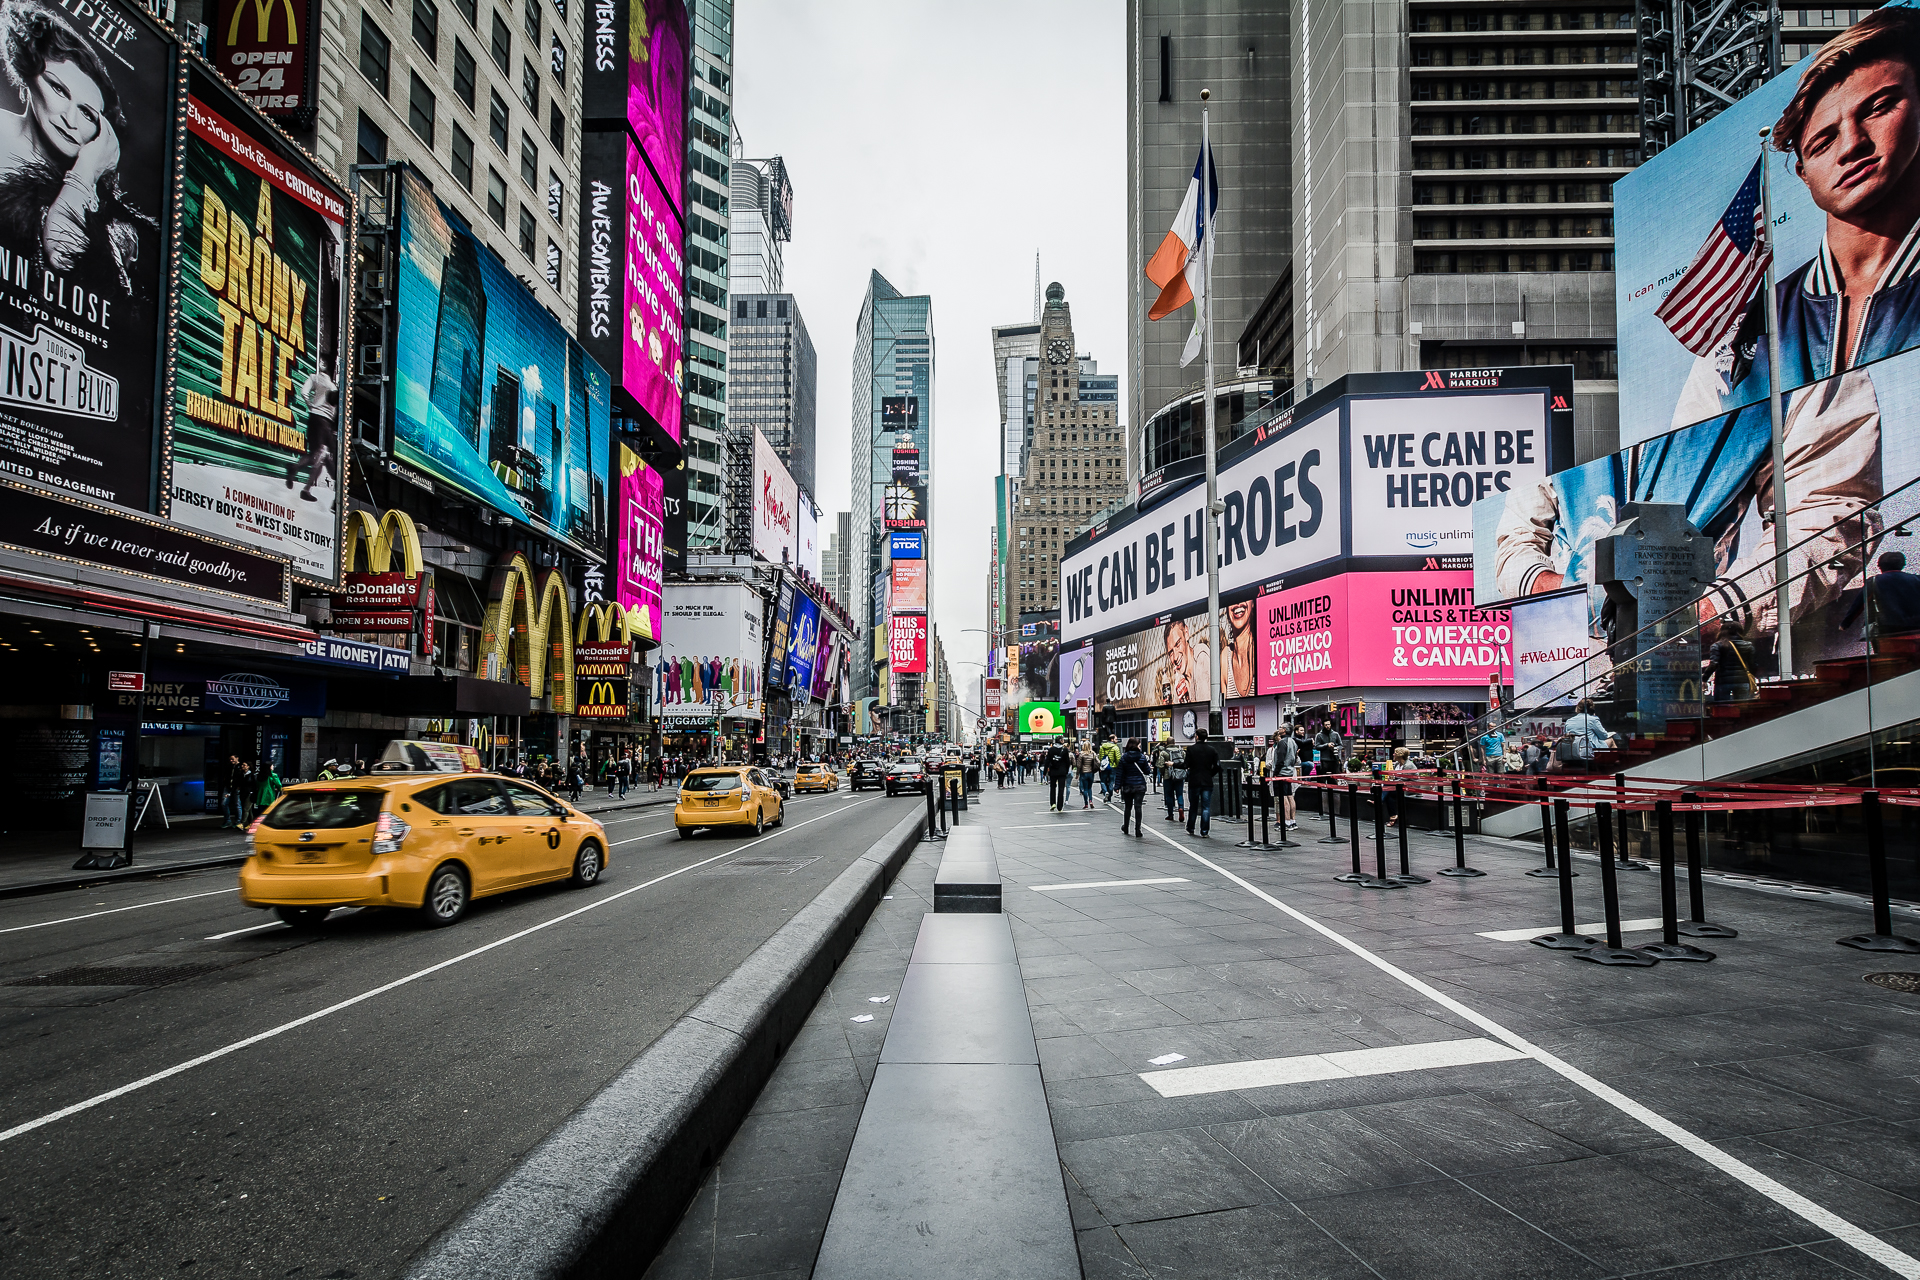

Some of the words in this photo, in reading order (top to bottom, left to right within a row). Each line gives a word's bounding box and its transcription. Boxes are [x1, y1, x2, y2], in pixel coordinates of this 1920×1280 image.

[231, 52, 293, 65] OPEN
[238, 68, 285, 90] 24
[187, 101, 206, 126] The
[207, 117, 230, 143] New
[230, 132, 256, 163] York
[255, 150, 285, 181] Times
[324, 196, 345, 218] PICK
[255, 178, 273, 243] A
[629, 173, 655, 227] Our
[655, 218, 684, 278] show
[201, 184, 306, 353] BRONX
[590, 179, 612, 339] AWESOMENESS
[629, 211, 684, 316] Foursome
[1634, 283, 1654, 299] can
[1657, 265, 1688, 286] make
[29, 294, 38, 304] in
[43, 270, 111, 330] CLOSE
[628, 252, 659, 316] have
[660, 303, 680, 346] you
[9, 296, 49, 321] LLOYD
[54, 316, 109, 349] WEBBER'S
[46, 339, 68, 360] 10086
[218, 298, 294, 422] TALE
[1450, 369, 1504, 378] MARRIOTT
[1450, 378, 1498, 387] MARQUIS
[78, 370, 115, 417] BLVD.
[1268, 407, 1296, 429] MARRIOTT
[1268, 416, 1293, 437] MARQUIS
[20, 420, 64, 439] BOULEVARD
[248, 413, 266, 438] NEW
[266, 418, 278, 443] HIT
[278, 424, 305, 452] MUSICAL
[13, 439, 31, 450] BILLY
[33, 446, 57, 458] WILDER
[28, 431, 49, 443] LLOYD
[50, 439, 75, 451] WEBBER
[1363, 432, 1416, 469] WE
[1421, 430, 1487, 468] CAN
[1494, 429, 1535, 465] BE
[16, 447, 40, 459] LONNY
[41, 455, 60, 466] PRICE
[27, 438, 71, 457] CHRISTOPHER
[72, 453, 103, 467] HAMPTON
[38, 470, 116, 501] ENGAGEMENT
[1142, 467, 1166, 484] MARRIOTT
[1142, 475, 1163, 491] MARQUIS
[172, 486, 214, 511] JERSEY
[216, 501, 244, 521] BOYS
[245, 510, 253, 523] &
[254, 512, 282, 532] WEST
[282, 523, 303, 539] SIDE
[232, 489, 286, 519] COMBINATION
[286, 508, 296, 522] OF
[885, 519, 926, 527] TOSHIBA
[1406, 530, 1437, 541] music
[33, 516, 62, 536] As
[65, 523, 85, 546] if
[83, 530, 109, 548] we
[110, 539, 155, 559] never
[155, 550, 189, 568] said
[188, 558, 248, 583] goodbye.
[1634, 551, 1663, 560] FRANCIS
[1671, 552, 1696, 560] DUFFY
[1066, 564, 1093, 624] WE
[1097, 541, 1138, 613] CAN
[1145, 521, 1176, 596] BE
[1268, 595, 1332, 625] UNLIMITED
[1392, 609, 1443, 623] CALLS
[1446, 609, 1457, 622] &
[1459, 609, 1510, 622] TEXTS
[335, 617, 361, 625] OPEN
[363, 617, 375, 625] 24
[377, 617, 409, 625] HOURS
[894, 617, 918, 629] THIS
[1269, 625, 1295, 639] CALLS
[1296, 621, 1303, 633] &
[1303, 616, 1332, 632] TEXTS
[894, 628, 926, 640] BUD'S
[894, 639, 915, 650] FOR
[1269, 640, 1285, 658] TO
[1286, 630, 1333, 655] MEXICO
[1392, 626, 1423, 645] TO
[1425, 625, 1511, 645] MEXICO
[330, 643, 378, 665] MONEY
[384, 653, 409, 670] ATM
[575, 647, 629, 656] McDonald's
[893, 650, 918, 662] YOU.
[1105, 645, 1127, 661] SHARE
[1127, 643, 1138, 655] AN
[1392, 646, 1409, 667] &
[1412, 646, 1511, 667] CANADA
[1106, 662, 1118, 675] ICE
[1118, 658, 1138, 673] COLD
[1269, 662, 1279, 677] &
[1279, 650, 1333, 675] CANADA
[206, 683, 240, 695] MONEY
[242, 686, 290, 699] EXCHANGE
[1243, 708, 1254, 717] UNI
[1243, 717, 1254, 728] QLO
[99, 729, 126, 737] CHANGE
